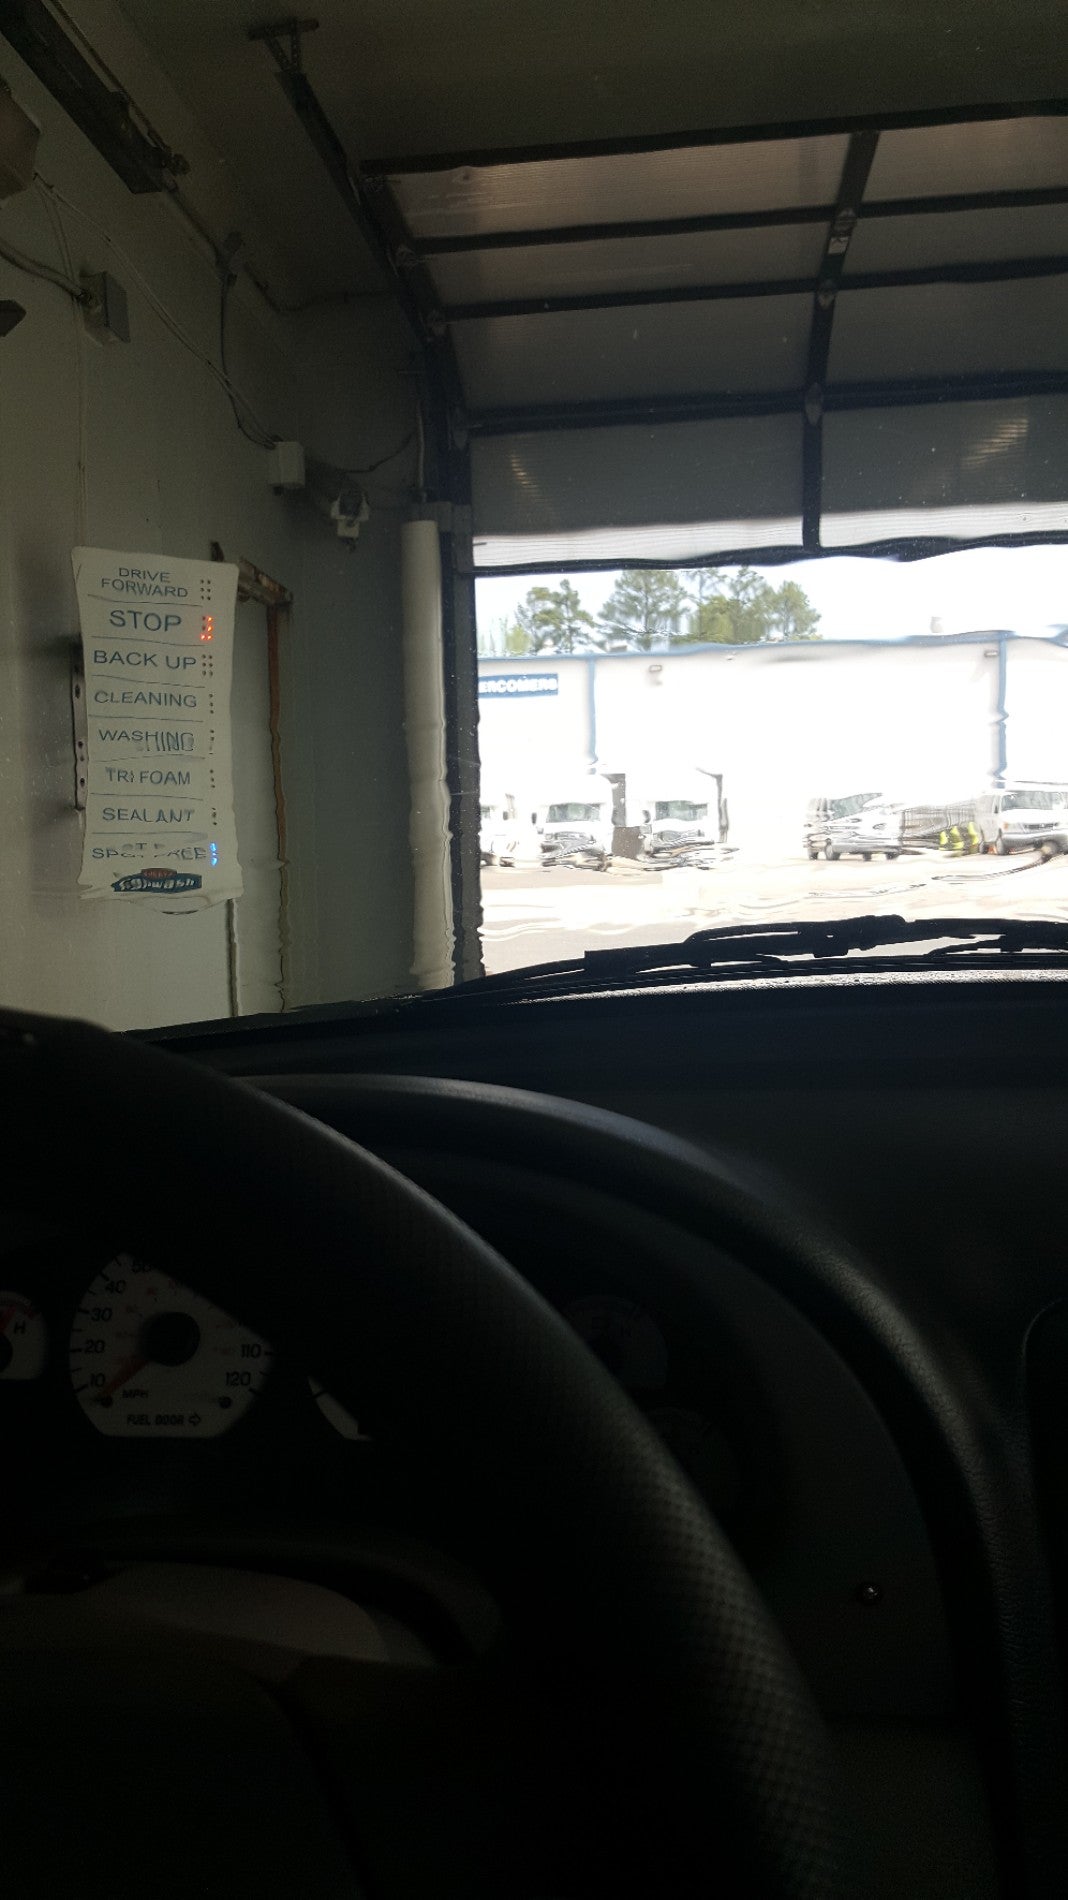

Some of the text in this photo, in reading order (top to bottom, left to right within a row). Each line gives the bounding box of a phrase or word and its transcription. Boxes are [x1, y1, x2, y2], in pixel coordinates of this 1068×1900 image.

[118, 567, 171, 583] DRIVE
[101, 578, 189, 598] FORWARD
[109, 610, 182, 632] STOP
[93, 650, 197, 670] BACK UP
[94, 690, 198, 708] CLEANING
[98, 729, 195, 752] WASHING
[139, 770, 191, 785] FOAM
[102, 807, 195, 823] SEALANT
[105, 1279, 127, 1294] 40
[91, 1307, 113, 1322] 30
[84, 1339, 106, 1354] 20
[240, 1343, 261, 1359] 110
[90, 1372, 106, 1388] 10
[225, 1371, 251, 1387] 120
[122, 1389, 149, 1399] MPH
[127, 1413, 151, 1426] FUEL
